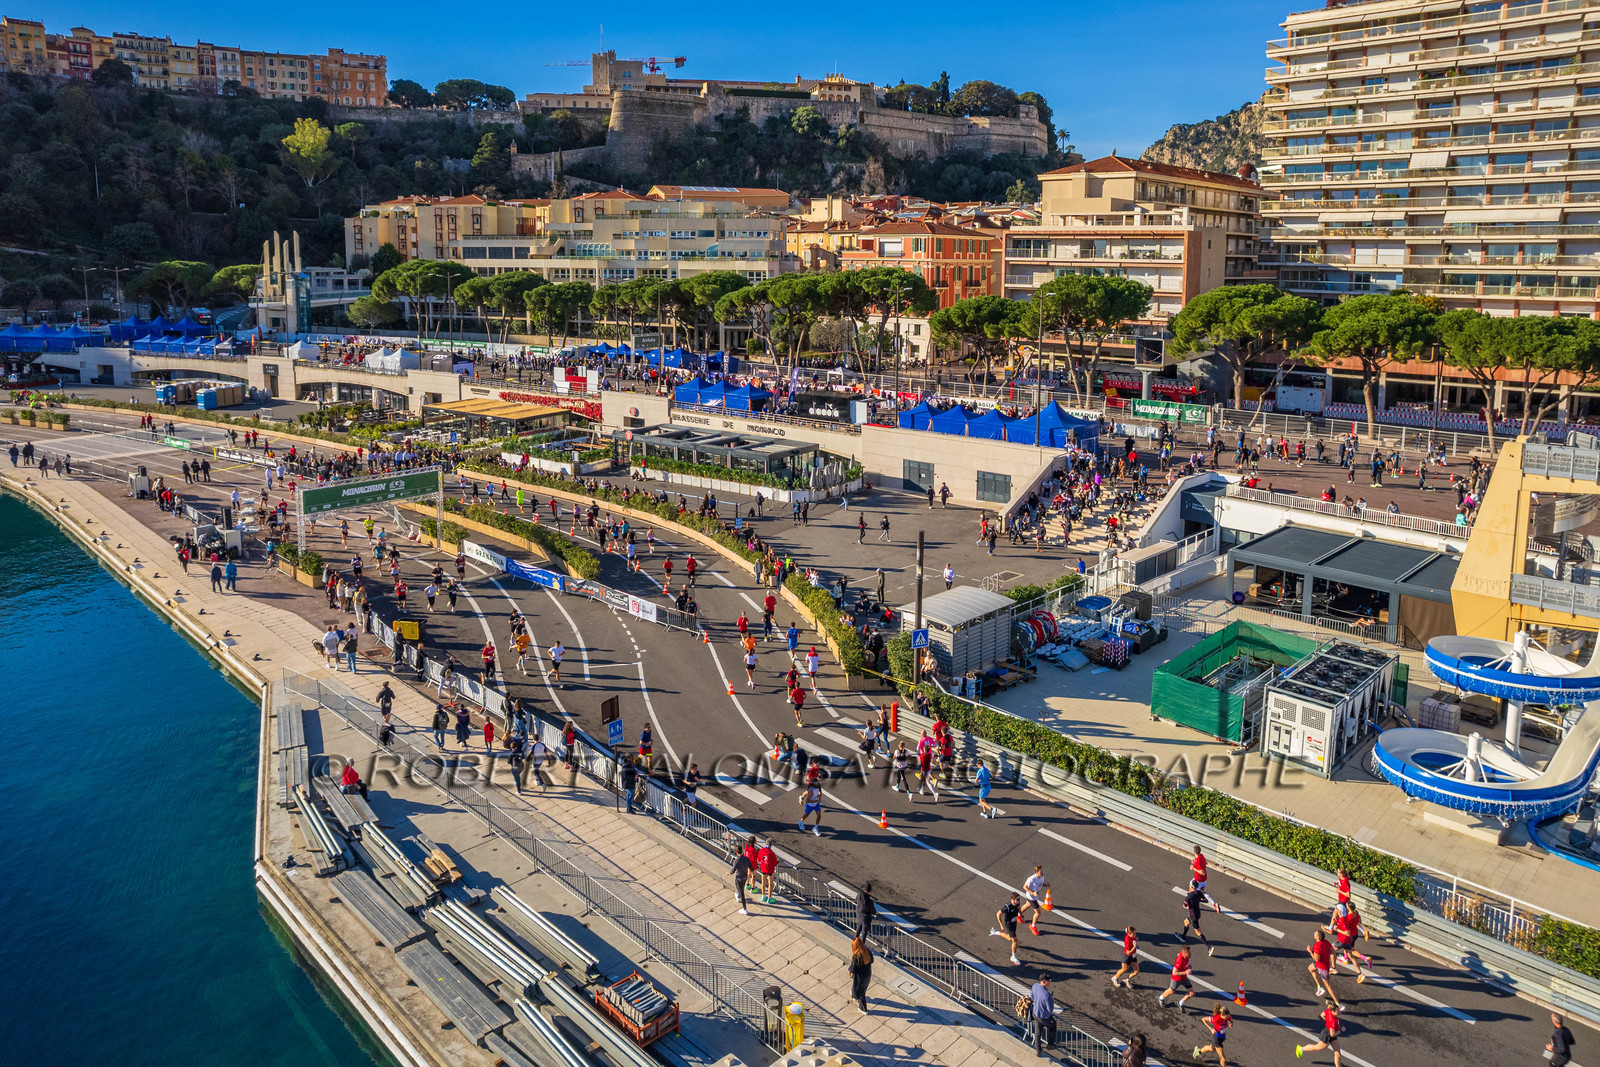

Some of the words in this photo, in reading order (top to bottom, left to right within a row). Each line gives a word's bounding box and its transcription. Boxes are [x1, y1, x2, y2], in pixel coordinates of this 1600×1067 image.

[672, 413, 710, 426] BRASSERIE
[722, 420, 734, 430] DE
[746, 424, 786, 437] MONACO
[342, 483, 386, 496] MONACORUN
[606, 590, 629, 602] CYCLE
